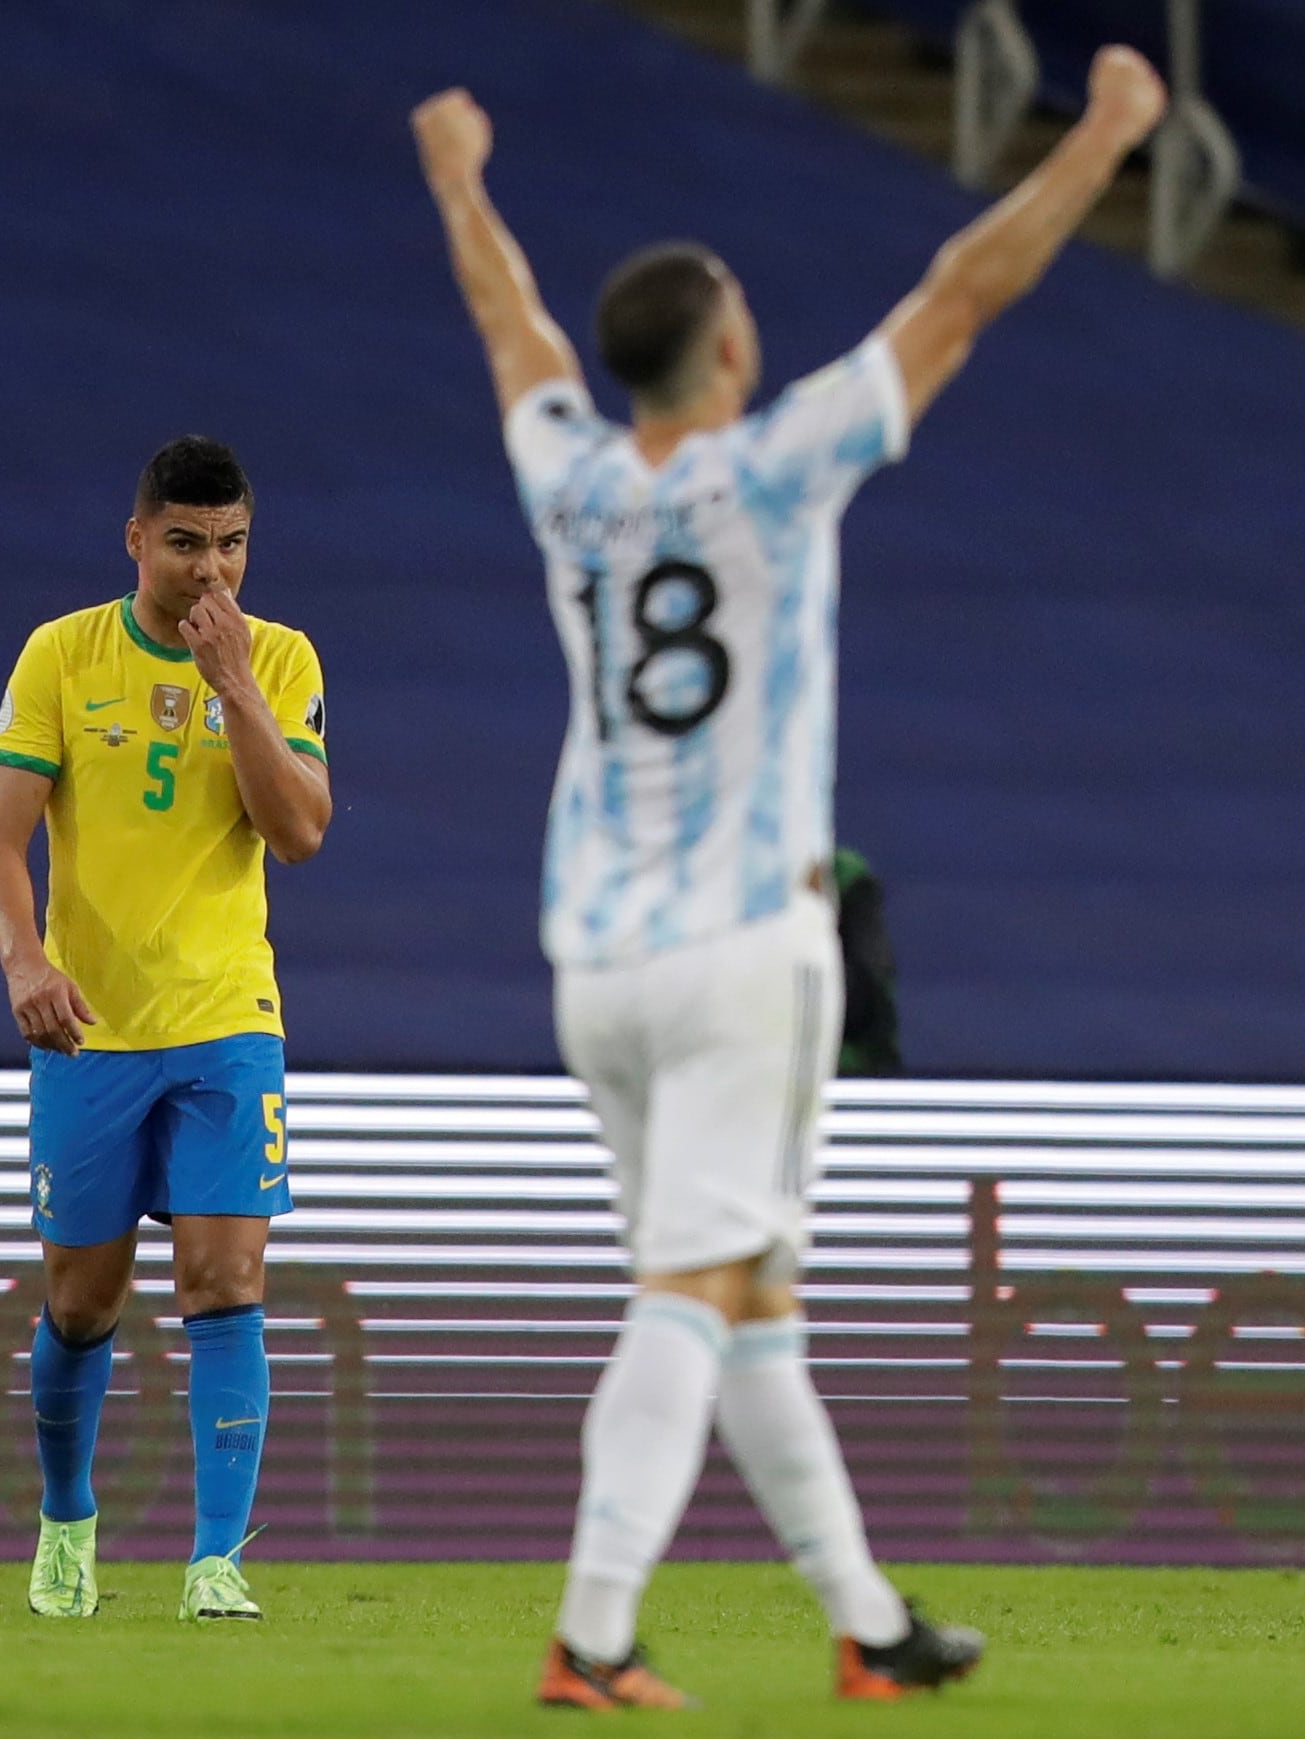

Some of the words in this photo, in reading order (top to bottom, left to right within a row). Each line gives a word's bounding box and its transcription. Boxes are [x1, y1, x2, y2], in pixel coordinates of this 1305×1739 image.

[574, 560, 730, 743] 18
[143, 741, 179, 813] 5
[261, 1093, 285, 1165] 5
